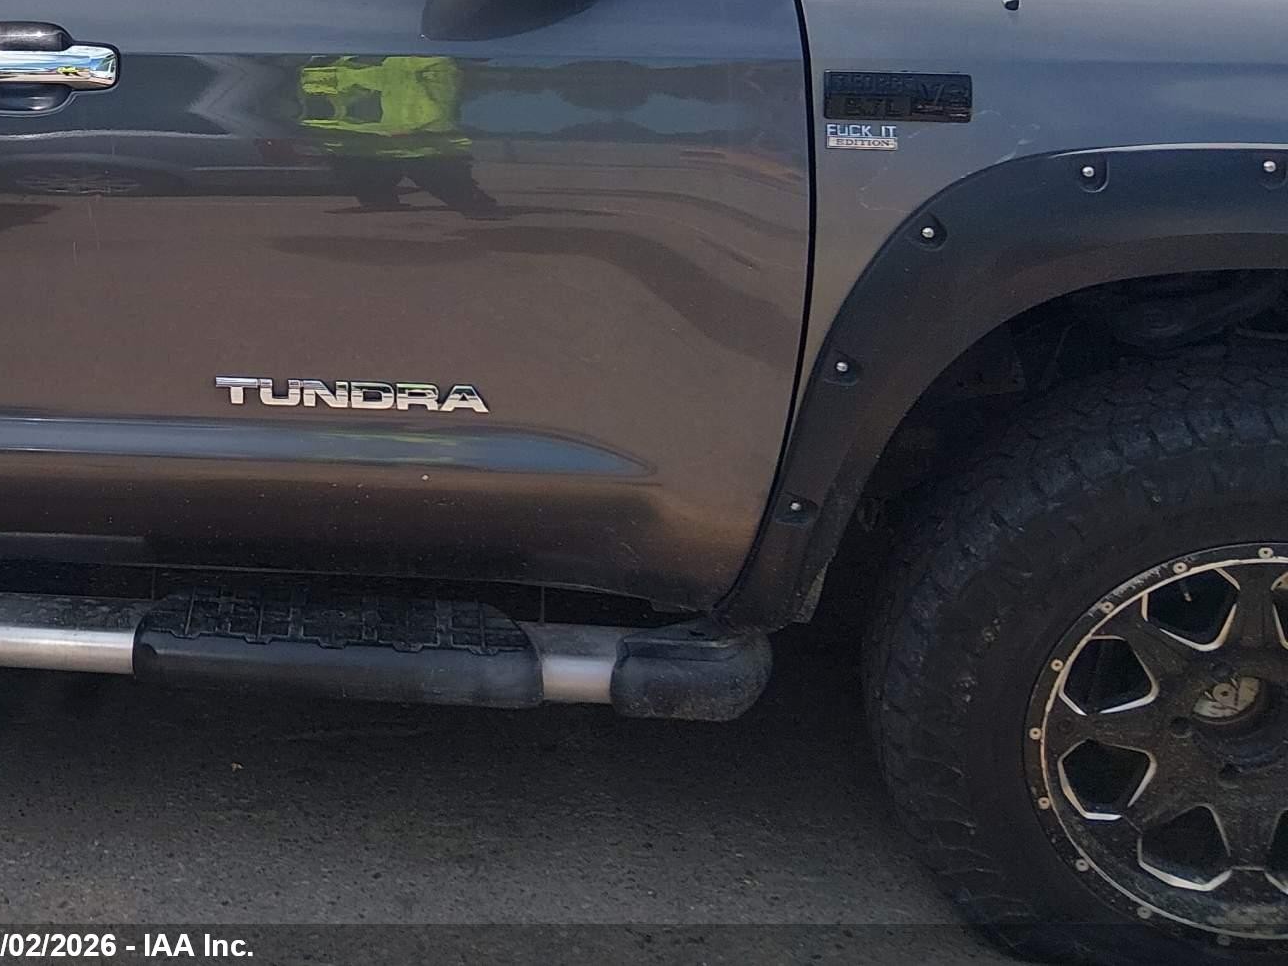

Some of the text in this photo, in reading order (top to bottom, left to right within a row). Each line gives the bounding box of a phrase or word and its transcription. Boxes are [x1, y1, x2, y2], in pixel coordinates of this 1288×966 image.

[826, 124, 897, 138] FUCK IT
[835, 137, 891, 148] EDITION
[215, 376, 489, 413] TUNDRA
